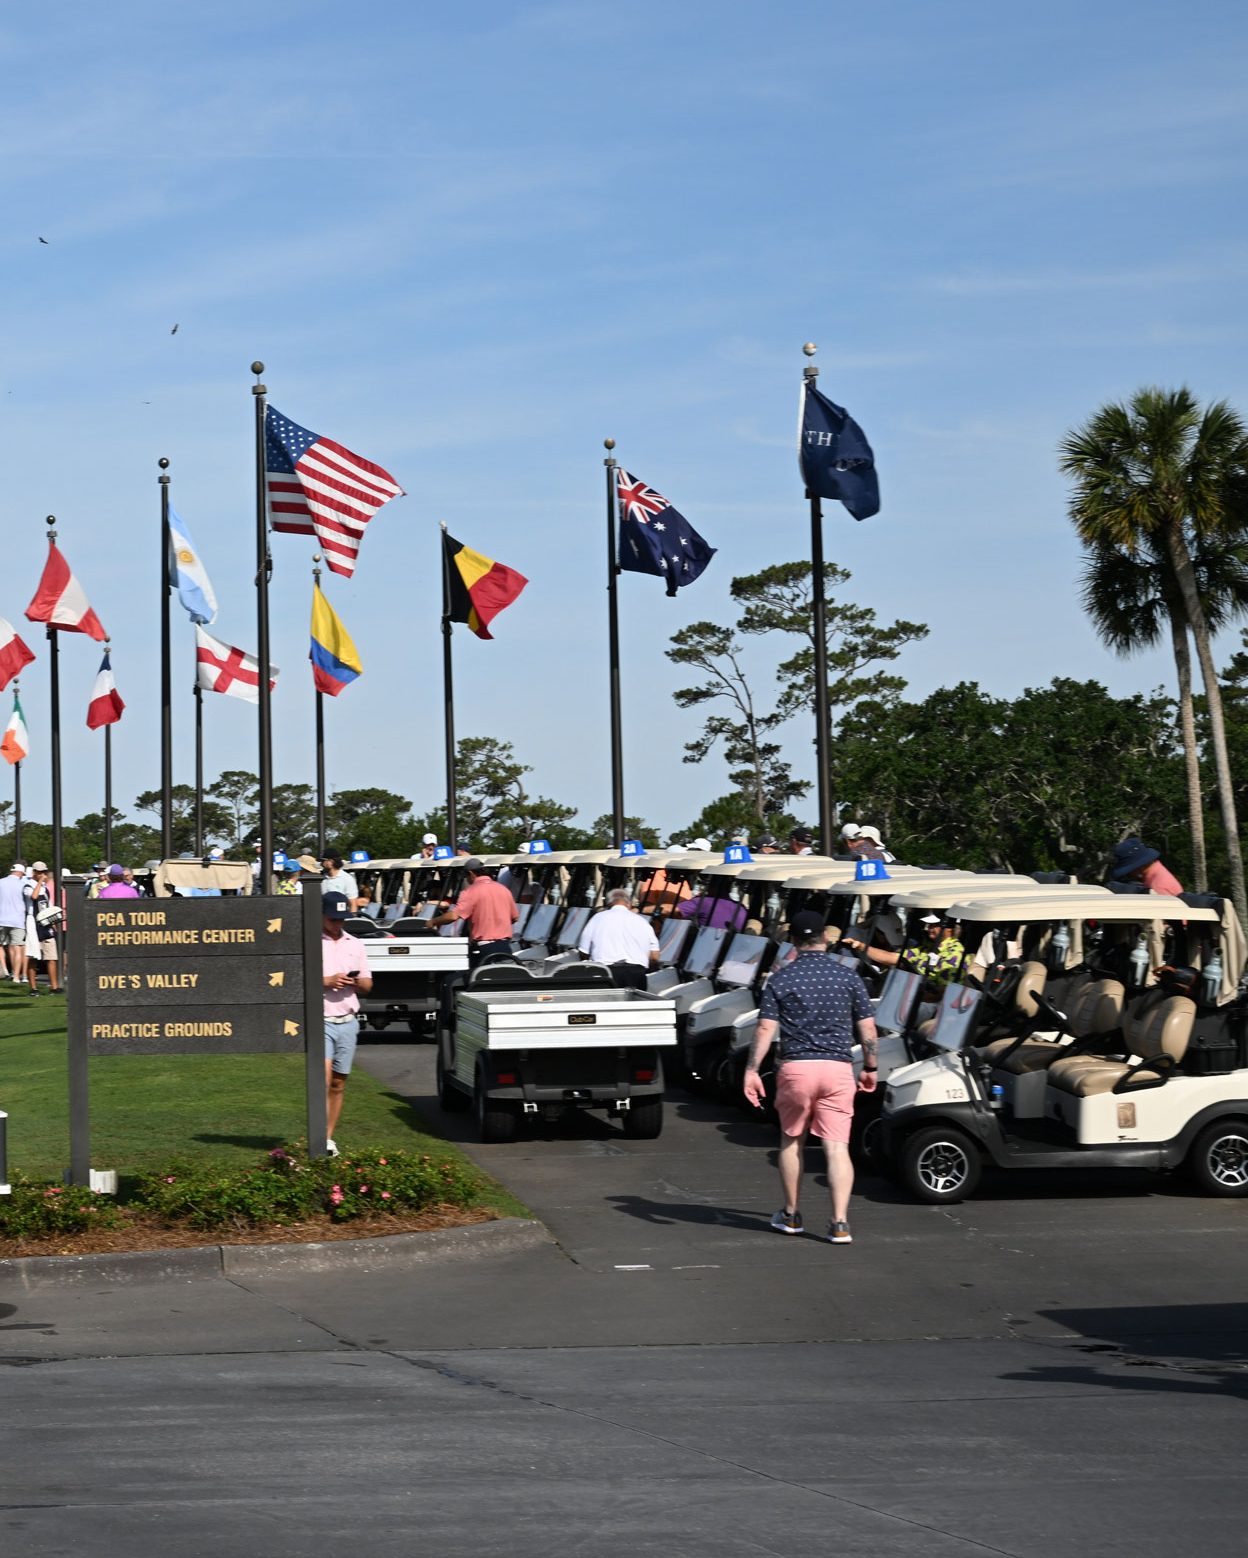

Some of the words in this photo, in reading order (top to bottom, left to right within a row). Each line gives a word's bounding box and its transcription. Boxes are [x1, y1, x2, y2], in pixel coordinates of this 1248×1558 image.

[805, 430, 840, 447] TH
[728, 849, 743, 860] 1A
[96, 913, 125, 926] PGA
[129, 912, 166, 925] TOUR
[97, 931, 199, 945] PERFORMANCE
[202, 929, 255, 943] CENTER
[98, 975, 141, 989] DYE'S
[146, 974, 198, 988] VALLEY
[92, 1024, 160, 1038] PRACTICE
[164, 1022, 232, 1037] GROUNDS
[946, 1089, 963, 1099] 123
